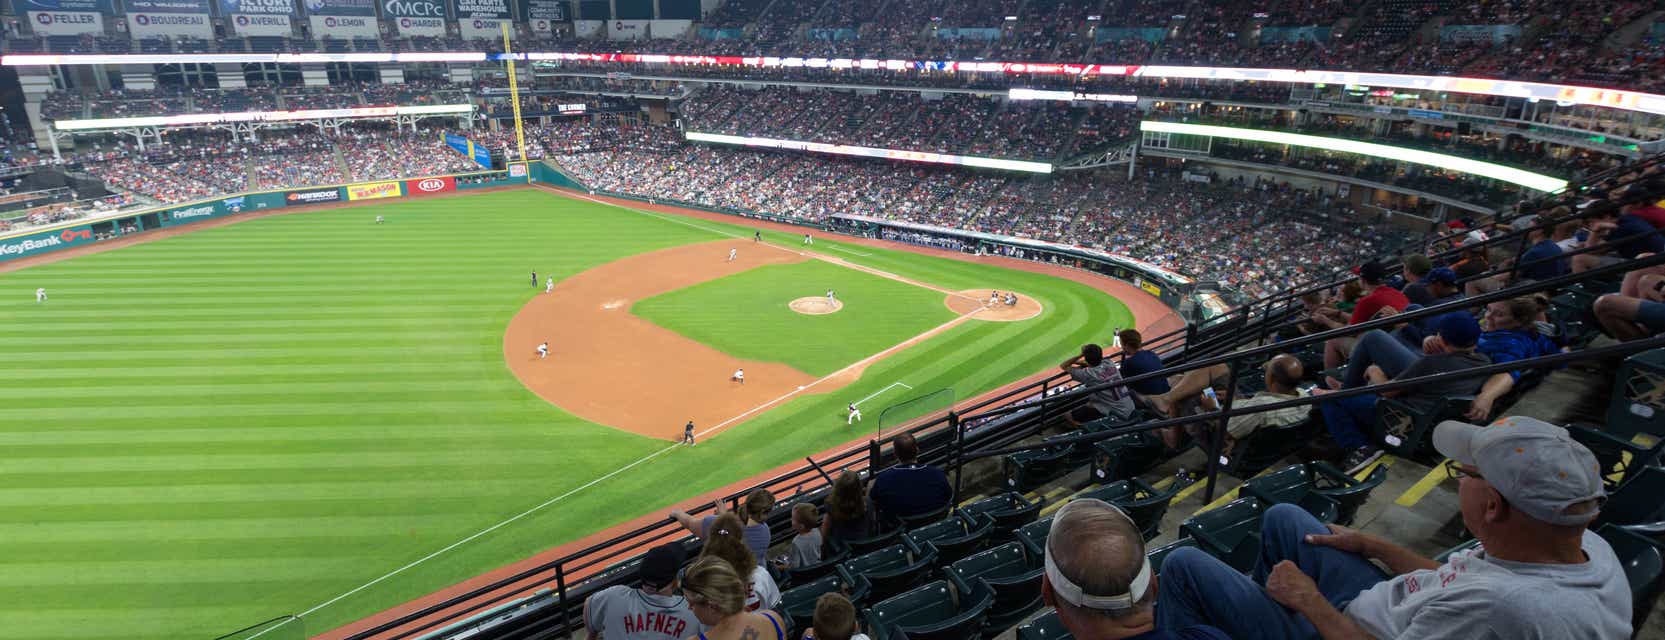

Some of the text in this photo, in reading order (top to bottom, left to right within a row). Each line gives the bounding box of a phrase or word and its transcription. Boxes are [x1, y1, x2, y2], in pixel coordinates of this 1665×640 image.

[239, 5, 266, 13] PARK
[394, 2, 444, 16] MCPc
[458, 5, 508, 13] WAREHOUSE
[54, 14, 95, 24] FELLER
[151, 16, 204, 25] BOUDREAU
[251, 18, 288, 26] AVERILL
[337, 18, 365, 27] LEMON
[411, 19, 442, 28] HARDER
[173, 205, 214, 219] FirstEnergy
[0, 236, 61, 255] KeyBank
[624, 612, 686, 638] HAFNER
